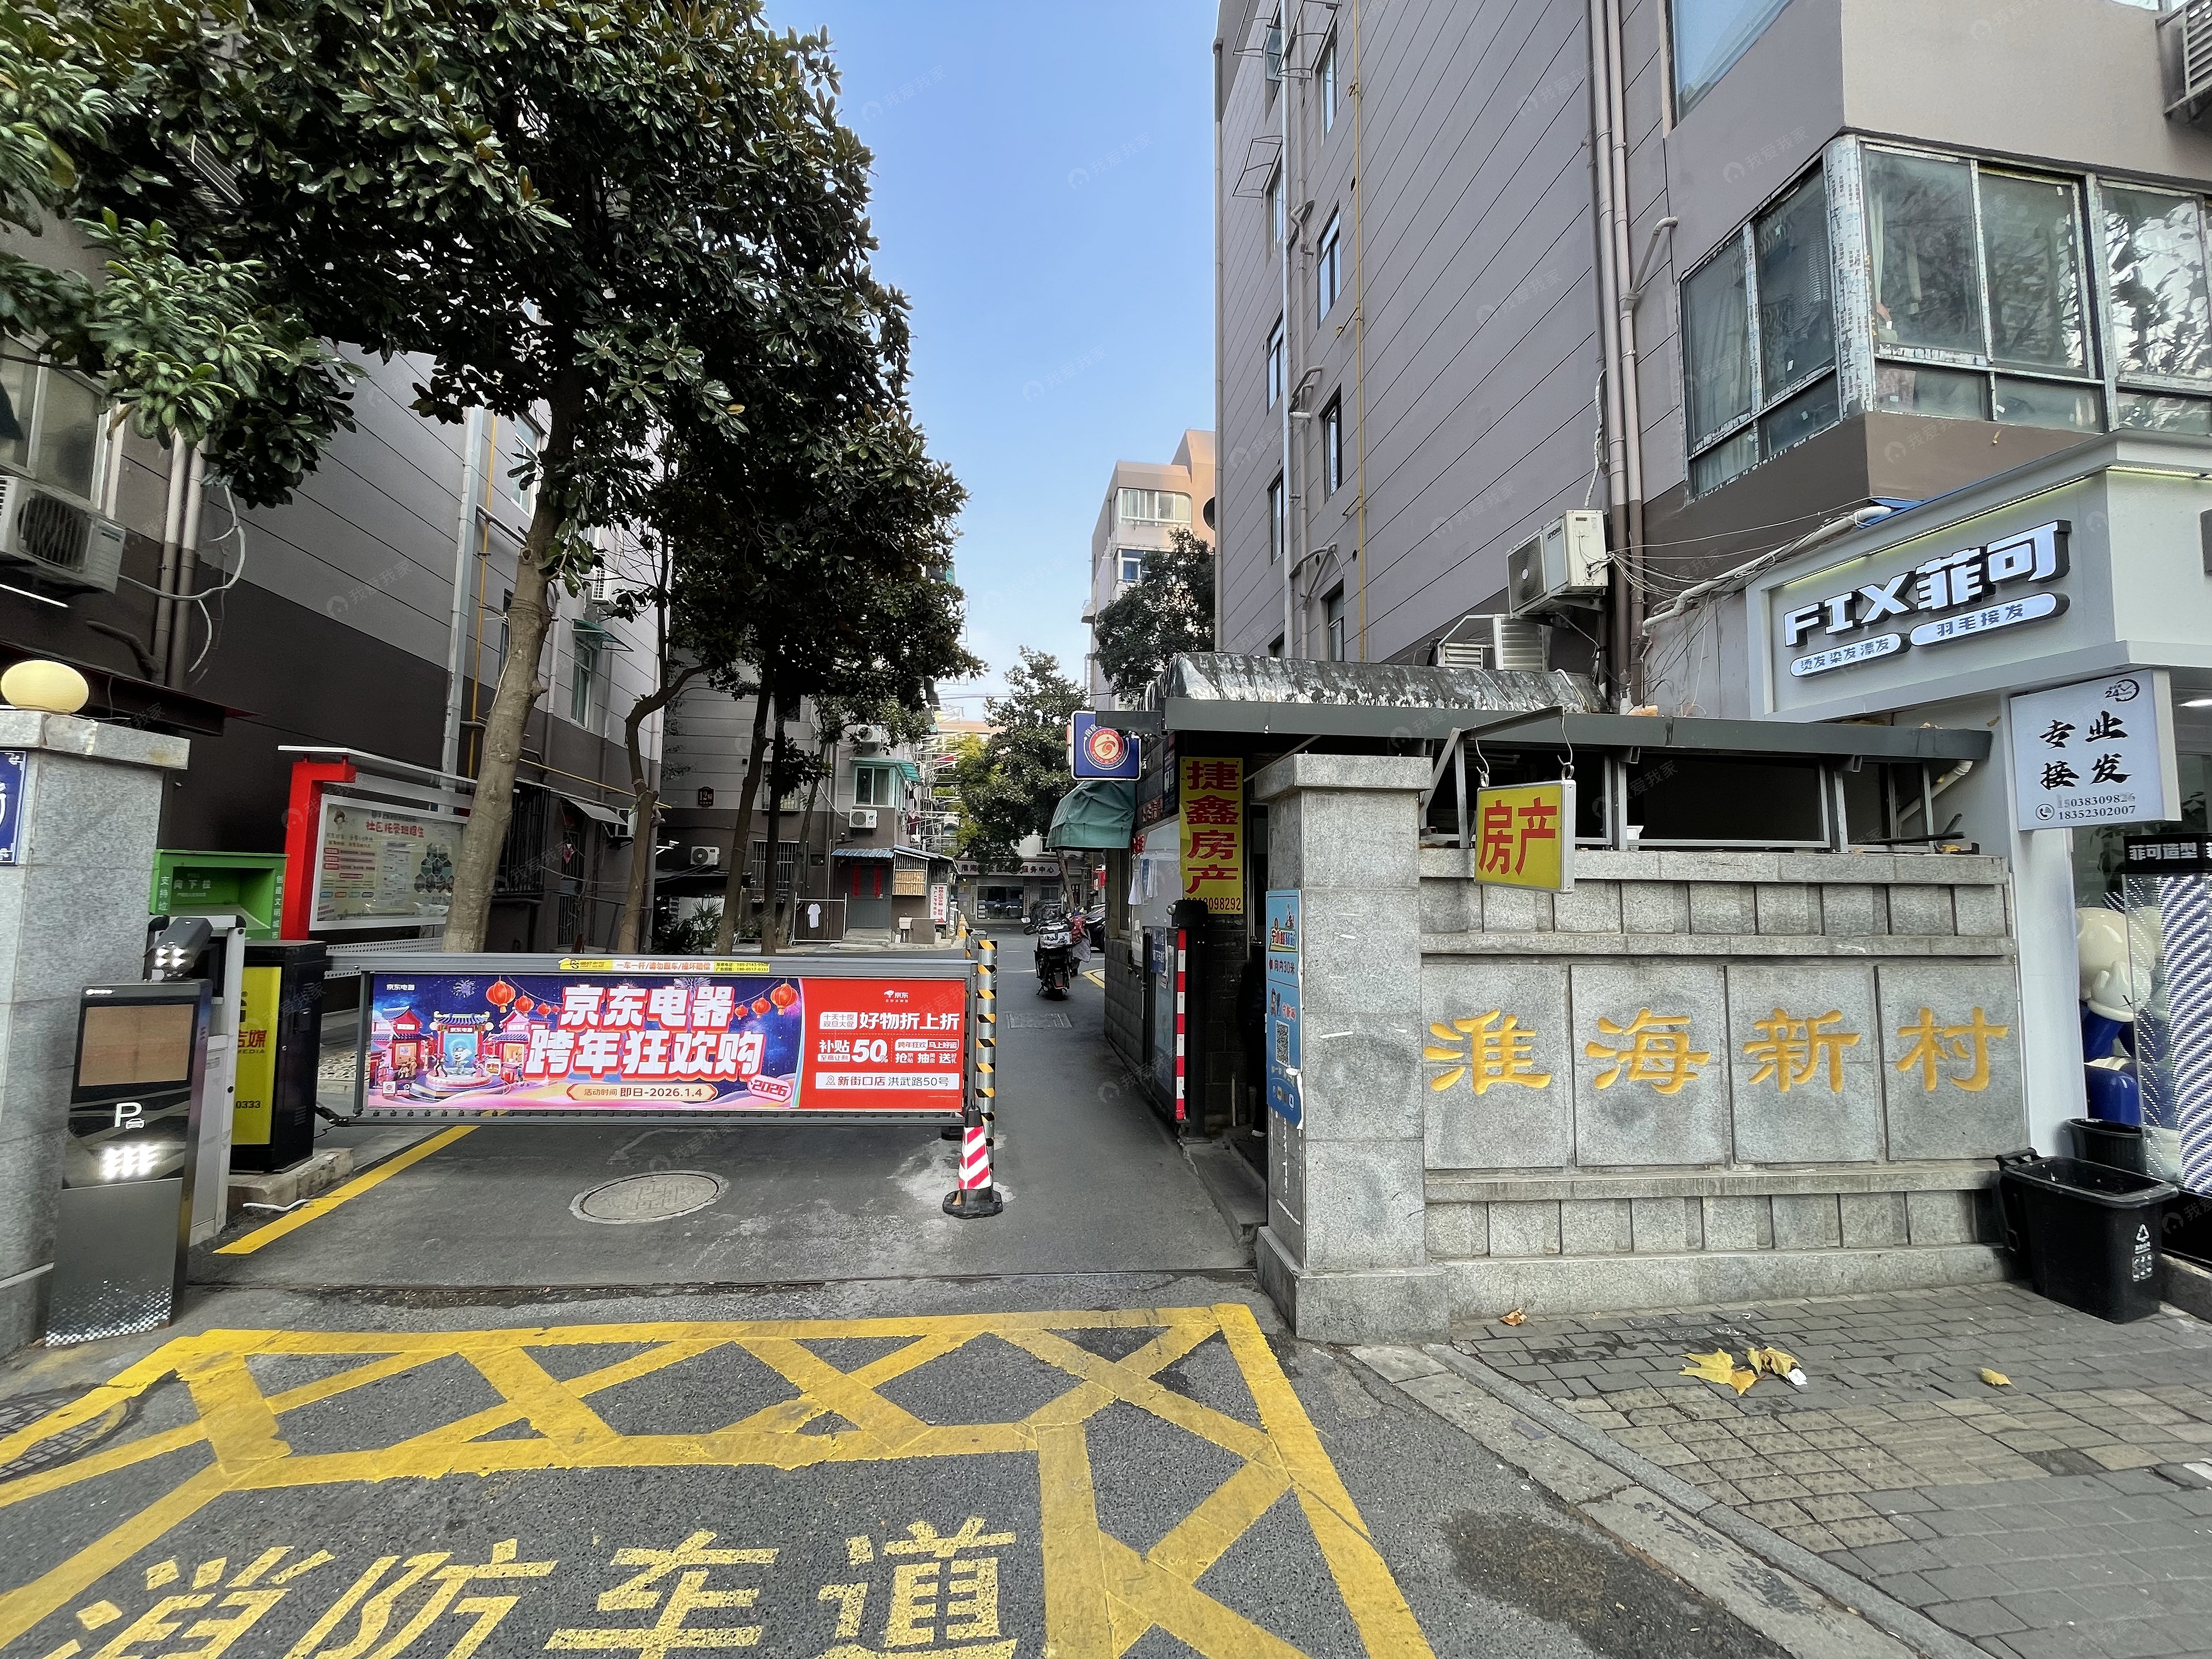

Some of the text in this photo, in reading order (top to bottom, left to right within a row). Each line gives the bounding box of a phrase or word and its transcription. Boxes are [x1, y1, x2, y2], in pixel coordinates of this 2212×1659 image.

[1937, 603, 2023, 637] 羽毛接发
[2039, 710, 2130, 749] 专业
[2040, 753, 2132, 791] 接发
[2058, 805, 2136, 821] 18352302007
[1185, 760, 1240, 895] 捷鑫房产
[1478, 797, 1558, 876] 房产
[2129, 842, 2198, 860] 菲可造型
[560, 984, 734, 1027] 京东电器
[859, 1012, 960, 1030] 好物折上折
[528, 1030, 765, 1075] 跨年狂欢购
[819, 1039, 850, 1053] 补贴
[1424, 1006, 2009, 1096] 淮海新村
[584, 1088, 618, 1097] 活动时间
[619, 1087, 703, 1098] 即日-2026.1.4
[751, 1079, 789, 1097] 2026
[837, 1076, 886, 1086] 新街口店
[888, 1076, 950, 1087] 洪武路50号
[114, 1102, 143, 1128] P
[38, 1517, 1018, 1659] 消防车道
